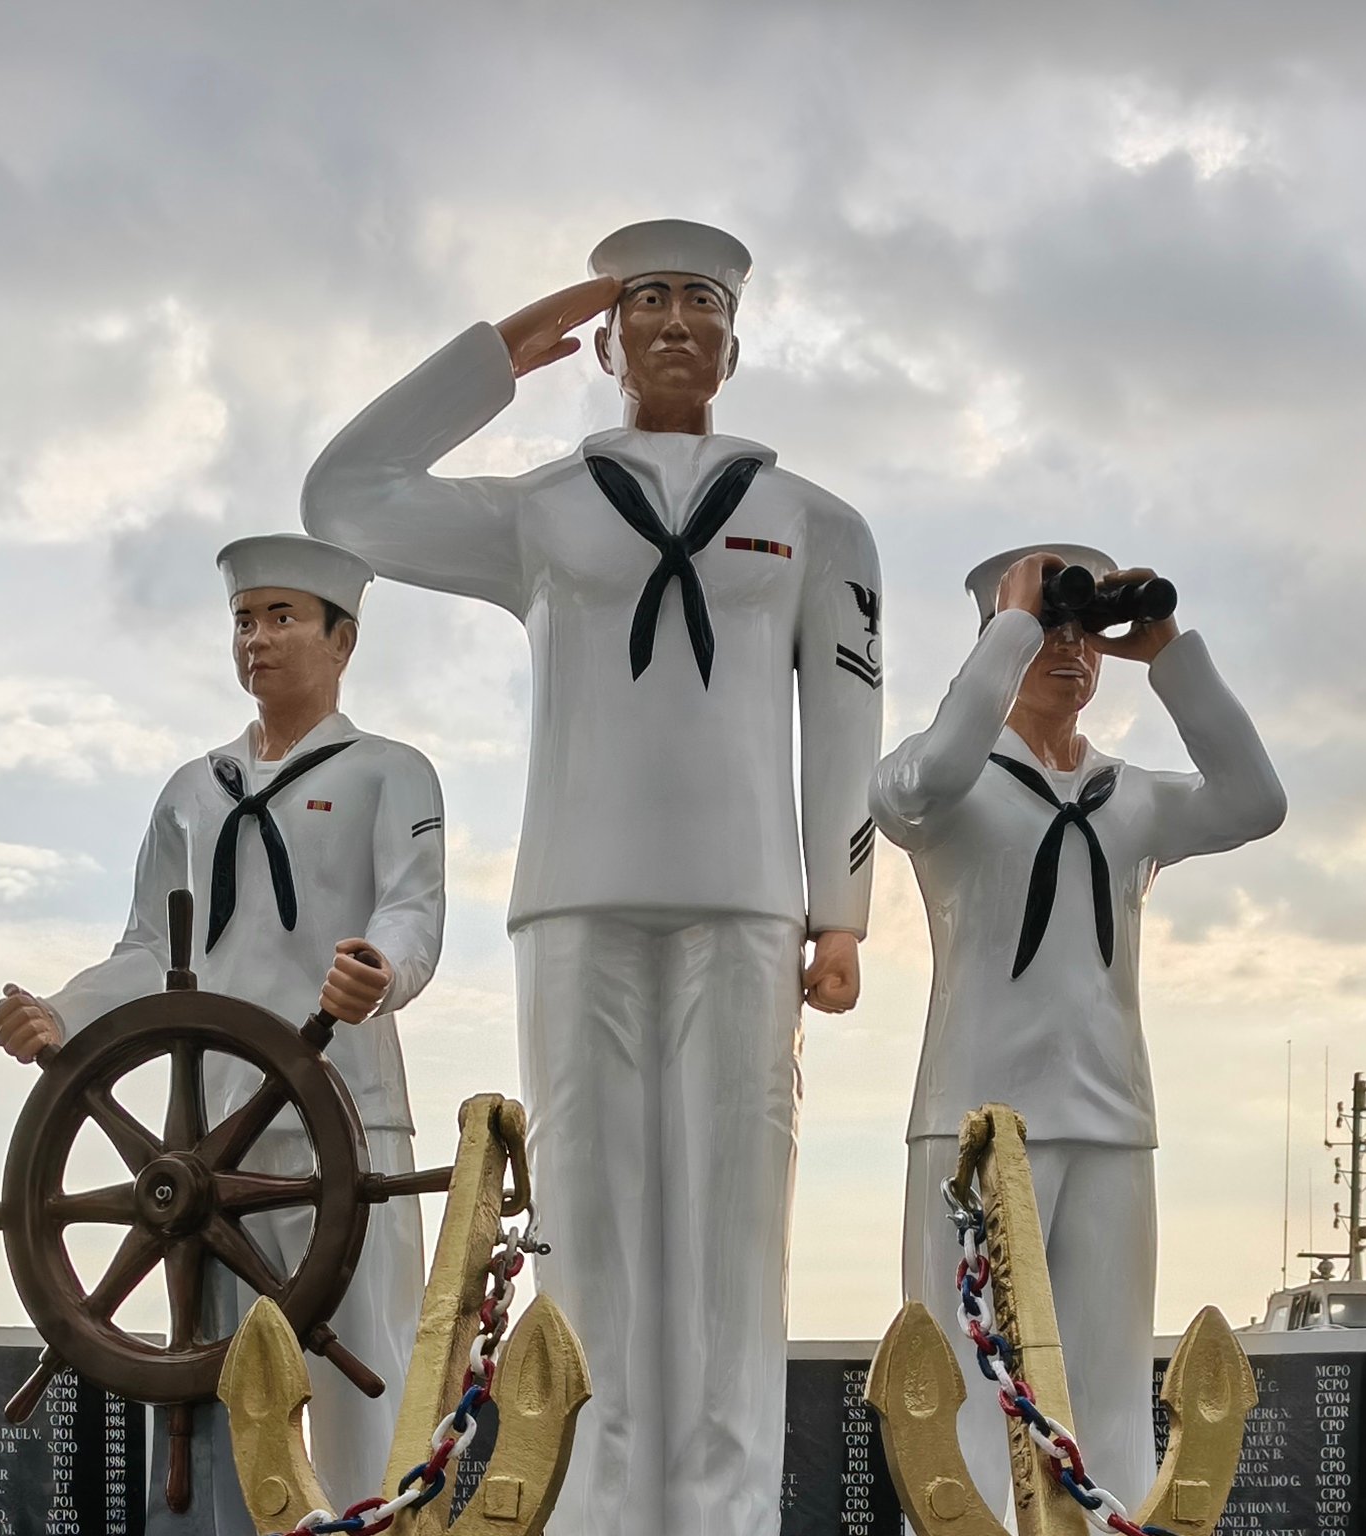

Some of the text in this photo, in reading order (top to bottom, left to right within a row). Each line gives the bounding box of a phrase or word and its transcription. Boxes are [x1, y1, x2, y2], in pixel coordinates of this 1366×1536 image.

[1315, 1365, 1350, 1377] MCPO
[1317, 1379, 1348, 1391] SCPO
[46, 1401, 78, 1413] LCDR
[105, 1402, 126, 1414] 1987
[1316, 1406, 1349, 1418] LCDR
[842, 1421, 873, 1433] LCDR
[1320, 1420, 1345, 1432] CPO
[7, 1442, 17, 1453] B.
[47, 1441, 78, 1453] SCPO
[105, 1442, 126, 1454] 1984
[52, 1455, 73, 1467] PO1
[105, 1456, 126, 1468] 1986
[52, 1496, 73, 1508] PO1
[105, 1496, 126, 1508] 1996
